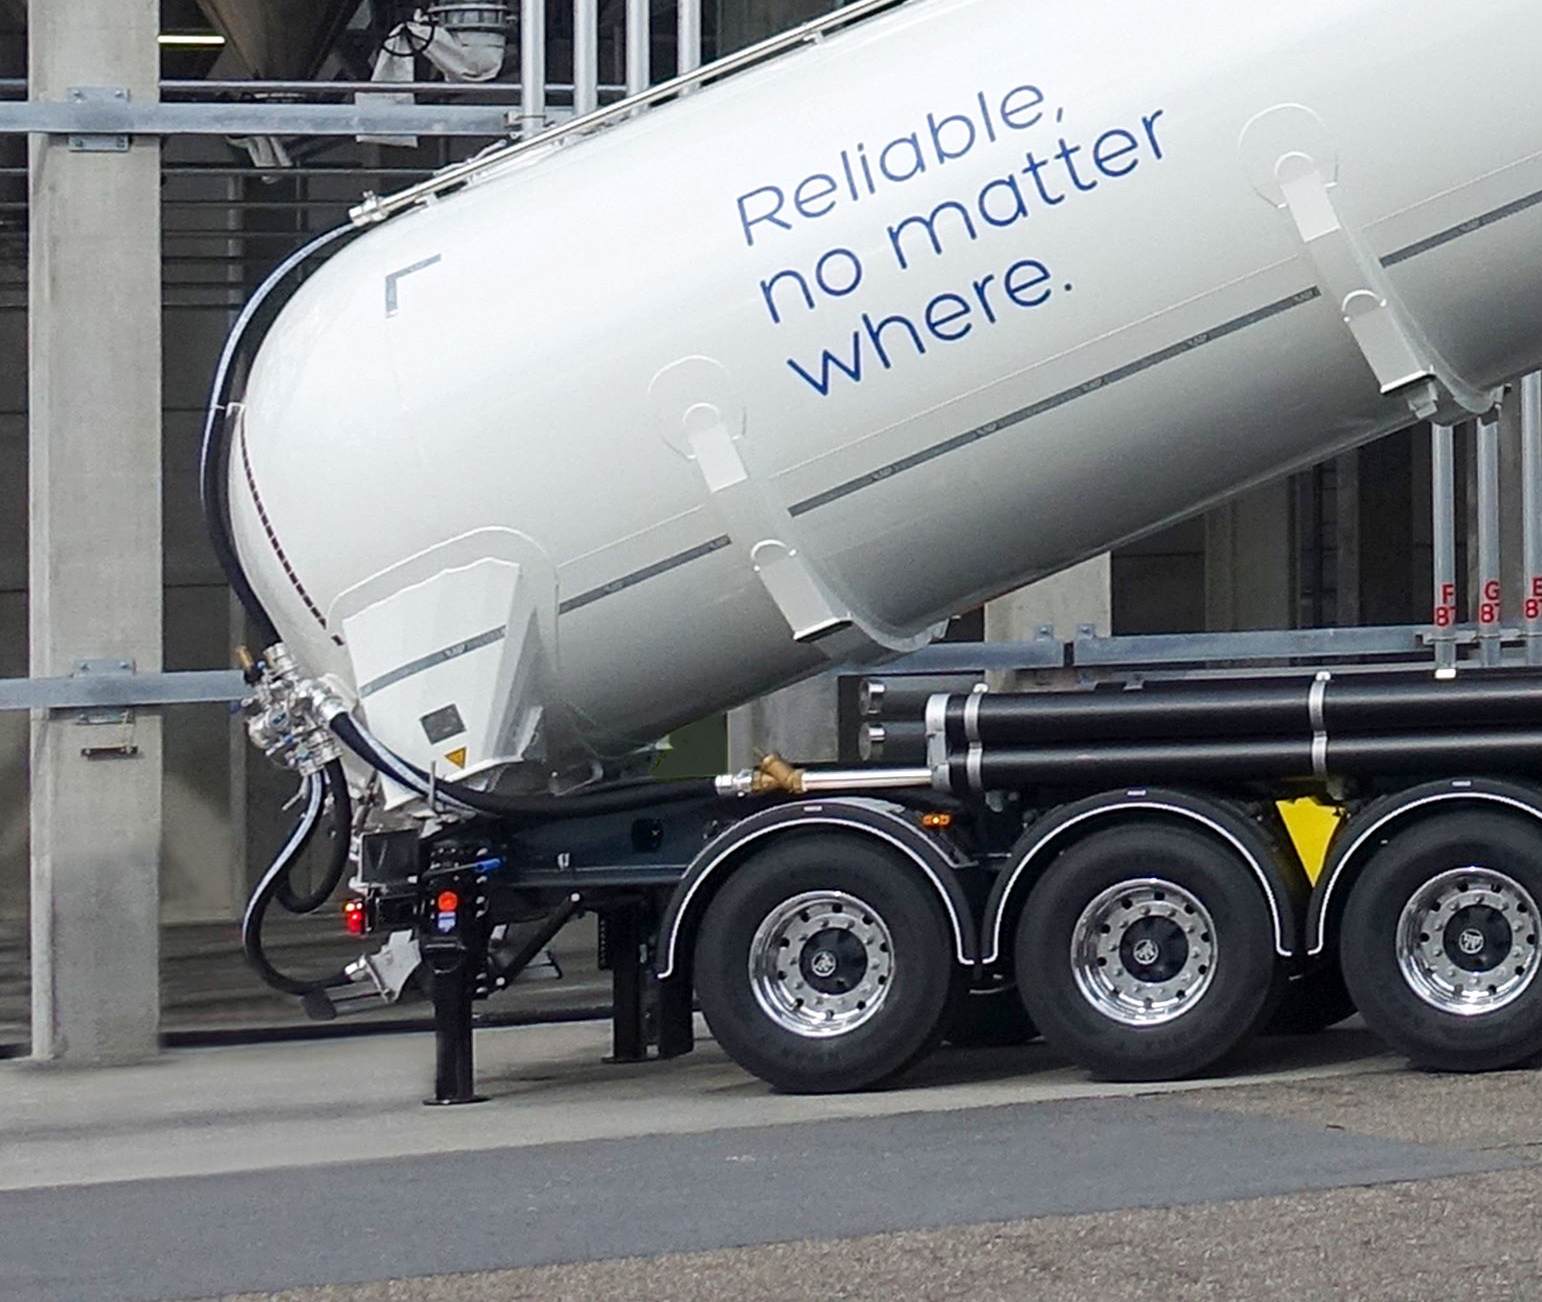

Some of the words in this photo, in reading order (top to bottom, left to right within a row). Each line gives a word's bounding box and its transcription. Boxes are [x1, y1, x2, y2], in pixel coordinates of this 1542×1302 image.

[736, 84, 1064, 247] Reliable,
[759, 247, 863, 324] no
[886, 109, 1164, 270] matter
[786, 258, 1073, 396] where.
